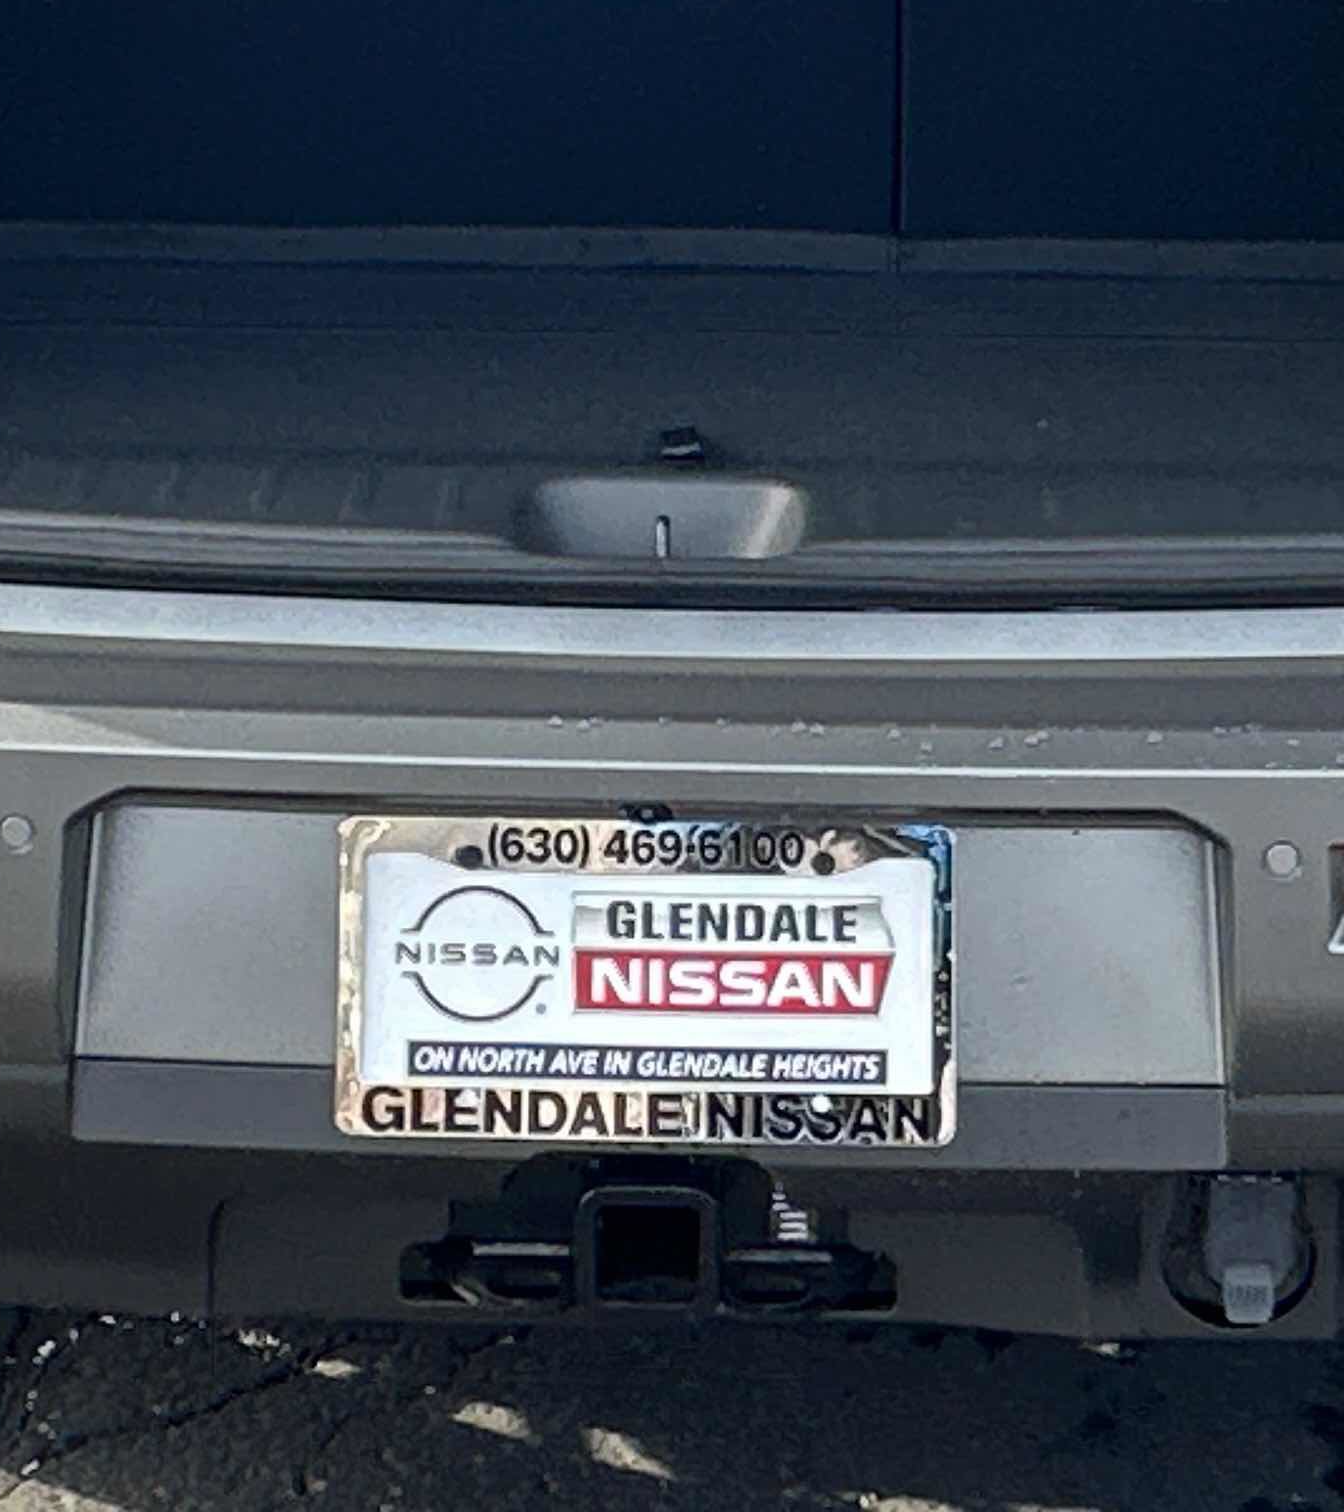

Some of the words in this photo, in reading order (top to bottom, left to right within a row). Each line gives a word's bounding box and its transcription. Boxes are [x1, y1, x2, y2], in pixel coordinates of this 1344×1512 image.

[488, 822, 590, 868] (630)
[603, 827, 806, 866] 469-6100
[606, 900, 857, 943] GLENDALE
[394, 941, 560, 968] NISSAN
[590, 957, 875, 1008] NISSAN
[414, 1046, 453, 1072] ON
[457, 1047, 546, 1074] NORTH
[548, 1048, 599, 1075] AVE
[602, 1050, 631, 1076] IN
[636, 1051, 767, 1078] GLENDALE
[771, 1054, 881, 1080] HEIGHTS
[361, 1088, 684, 1137] GLENDALE
[707, 1091, 933, 1143] NISSAN
